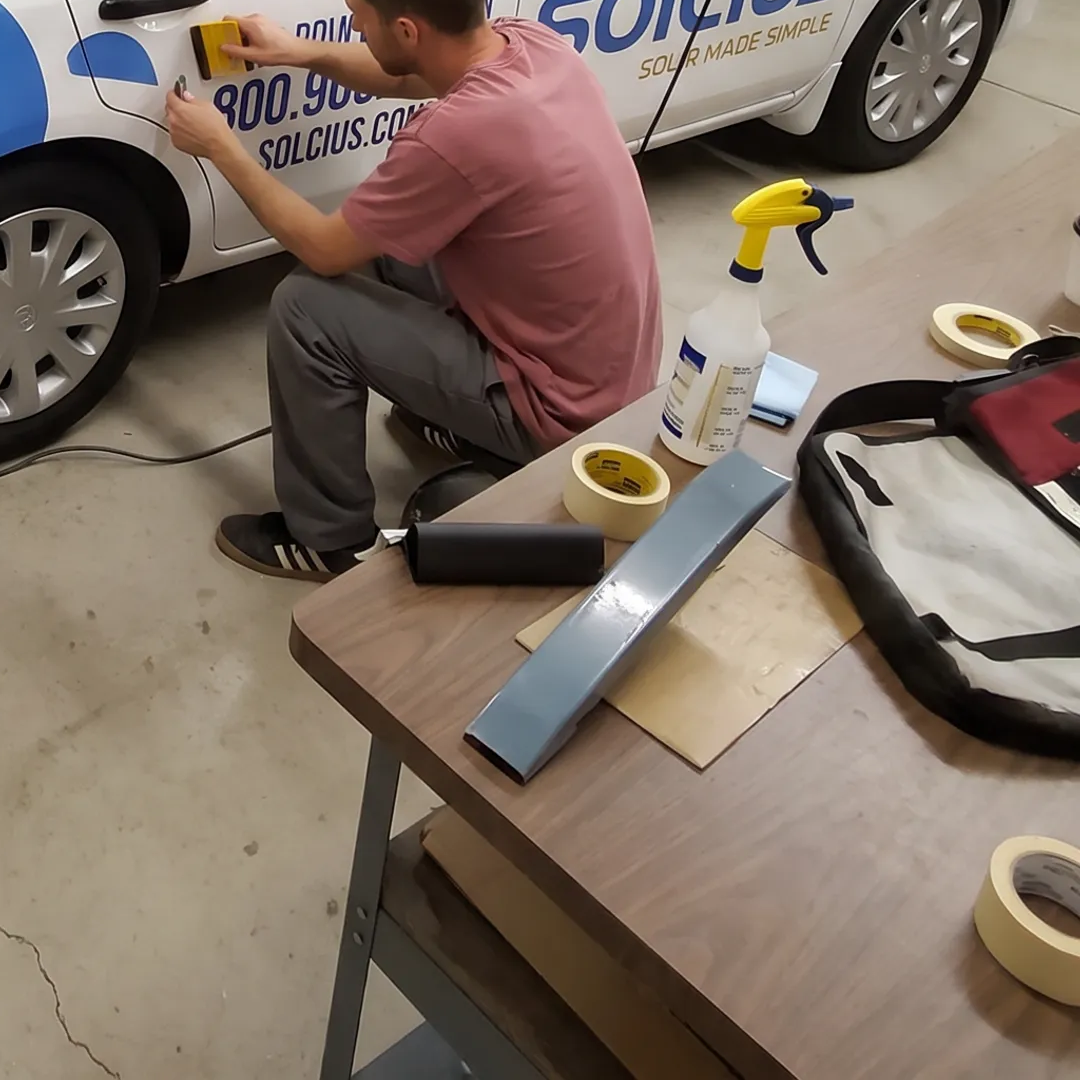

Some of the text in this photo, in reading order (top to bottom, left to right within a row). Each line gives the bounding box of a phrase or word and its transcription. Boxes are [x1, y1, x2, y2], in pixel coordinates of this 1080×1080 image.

[638, 12, 833, 80] SOLR MADE SIMPLE
